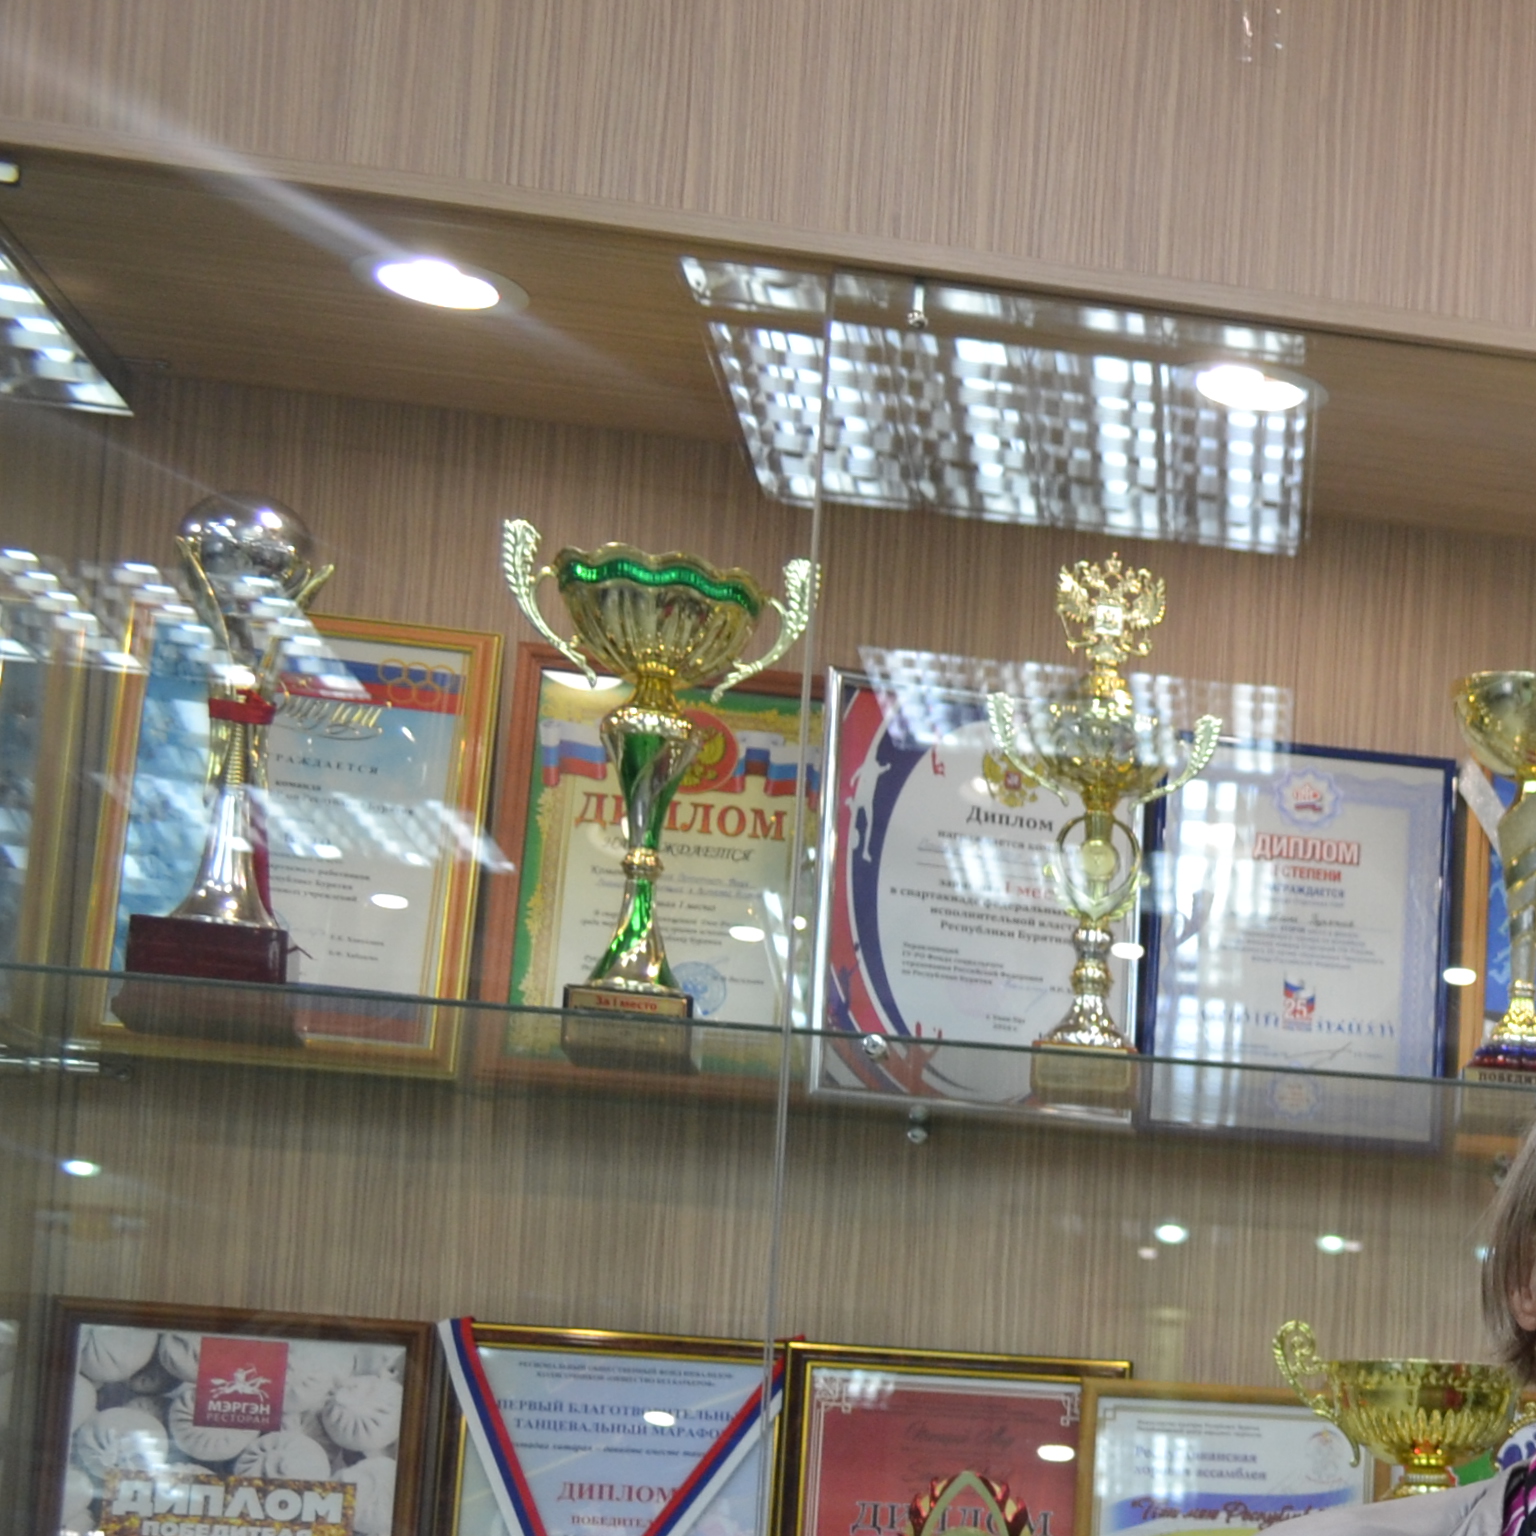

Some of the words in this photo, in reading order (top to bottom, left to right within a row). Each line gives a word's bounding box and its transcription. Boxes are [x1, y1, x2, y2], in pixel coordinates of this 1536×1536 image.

[967, 805, 1053, 831] Диплом
[1252, 832, 1360, 866] ДИПЛОМ
[1283, 998, 1309, 1019] 25
[207, 1400, 271, 1416] МЭРГЭН
[206, 1413, 270, 1425] РЕСТОРАН
[514, 1417, 647, 1435] ТАНЦЕВАЛЬНЫЙ
[112, 1480, 345, 1524] ДИПЛОМ
